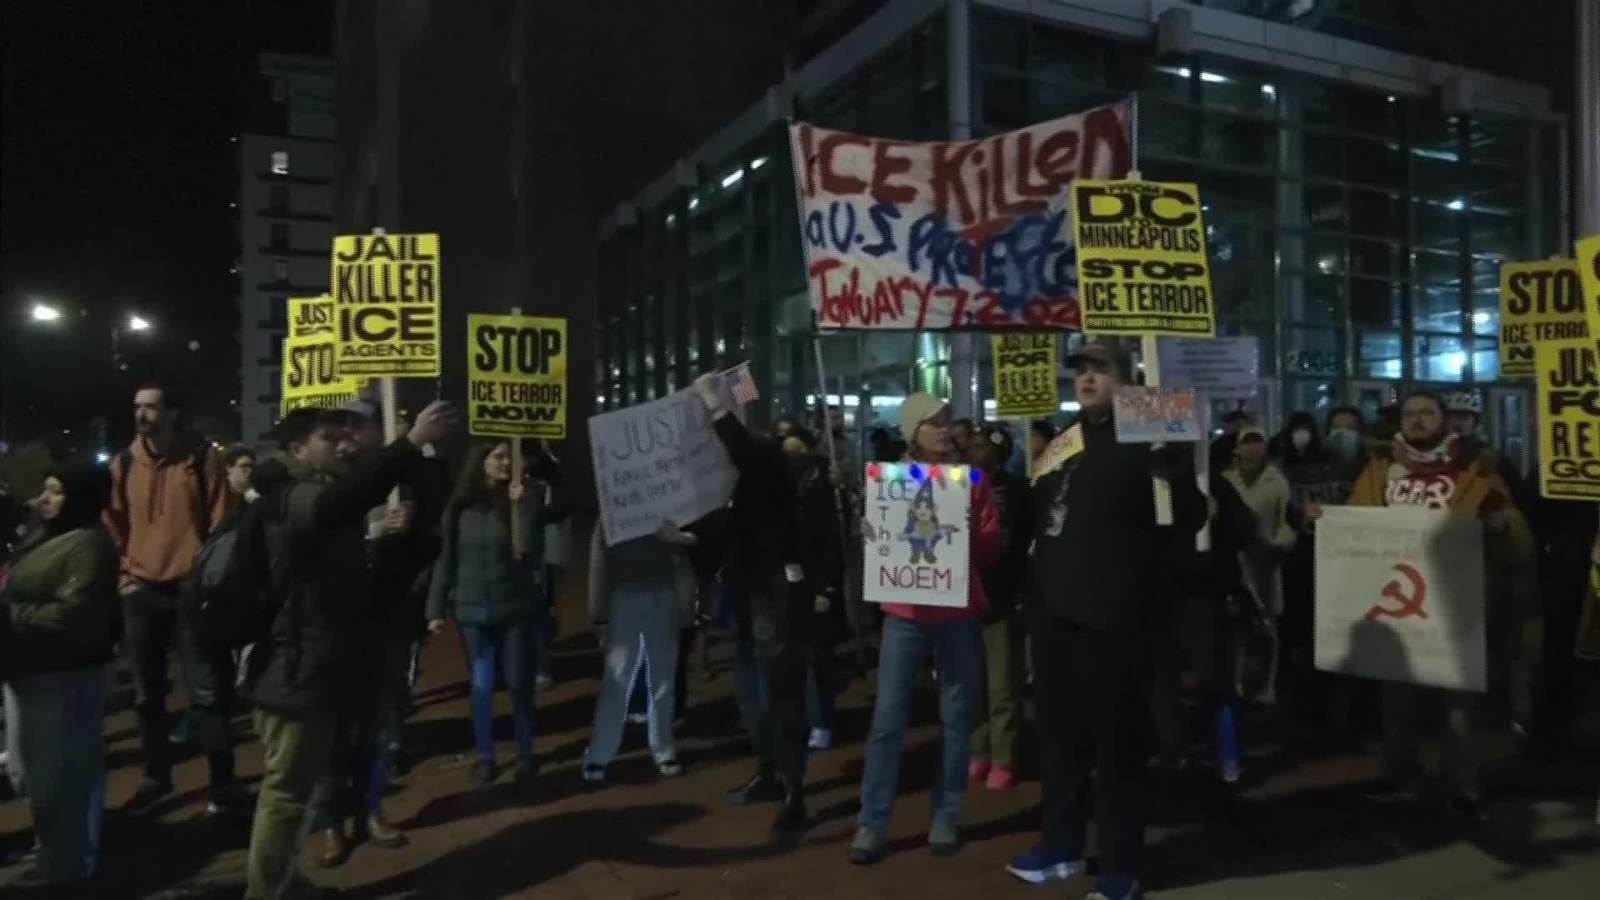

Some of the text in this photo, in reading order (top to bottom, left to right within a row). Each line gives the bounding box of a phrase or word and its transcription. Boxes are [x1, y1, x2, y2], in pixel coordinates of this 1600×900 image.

[800, 125, 918, 203] ICE
[1078, 187, 1197, 226] DC
[338, 236, 434, 261] JAIL
[1080, 226, 1200, 251] MINNEAPOLIS
[1083, 259, 1204, 280] STOP
[338, 263, 434, 303] KILLER
[1086, 283, 1208, 313] ICE TERROR
[296, 302, 334, 325] JUST
[341, 308, 434, 341] ICE
[1503, 323, 1529, 345] ICE
[340, 343, 435, 357] AGENTS
[475, 325, 561, 374] STOP
[999, 351, 1048, 369] FOR
[289, 343, 340, 387] STO
[472, 380, 562, 405] ICE TERROR
[1549, 391, 1600, 416] FO
[477, 405, 558, 421] NOW
[1550, 459, 1600, 479] GO
[876, 479, 914, 501] ICE
[880, 565, 952, 590] NOEM
